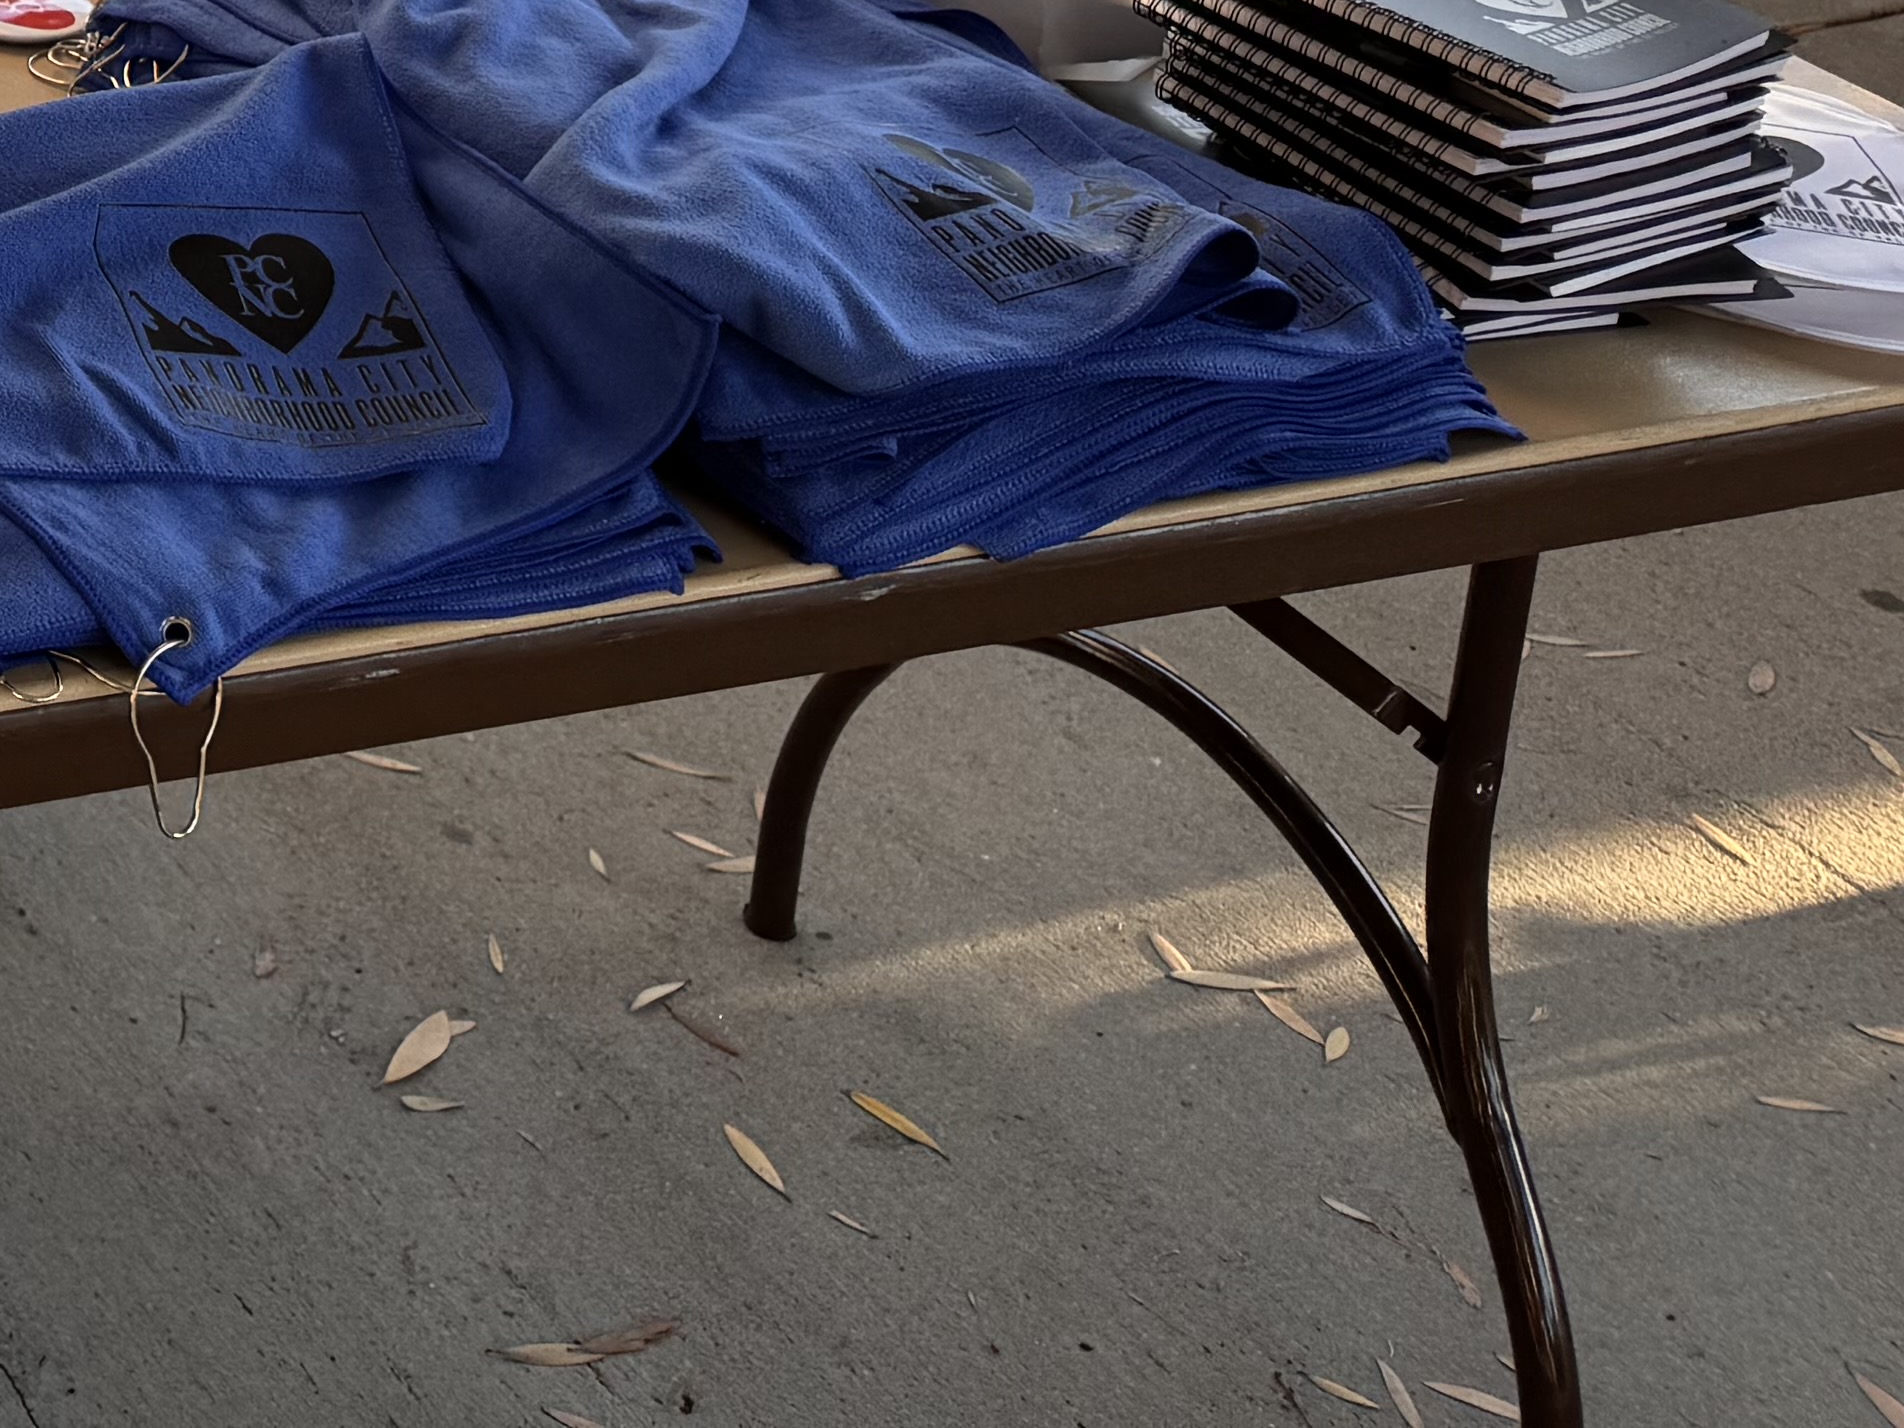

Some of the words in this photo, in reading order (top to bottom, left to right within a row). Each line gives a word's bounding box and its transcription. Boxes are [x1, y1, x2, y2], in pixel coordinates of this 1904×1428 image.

[931, 208, 1027, 253] PANO
[219, 254, 293, 285] PC
[962, 232, 1085, 283] NEIGHBO
[229, 280, 305, 320] NC
[156, 357, 342, 397] PANORAMA
[356, 355, 442, 394] CITY
[171, 383, 356, 432] NEIGHBORHOOD
[354, 388, 461, 427] COUNCIL
